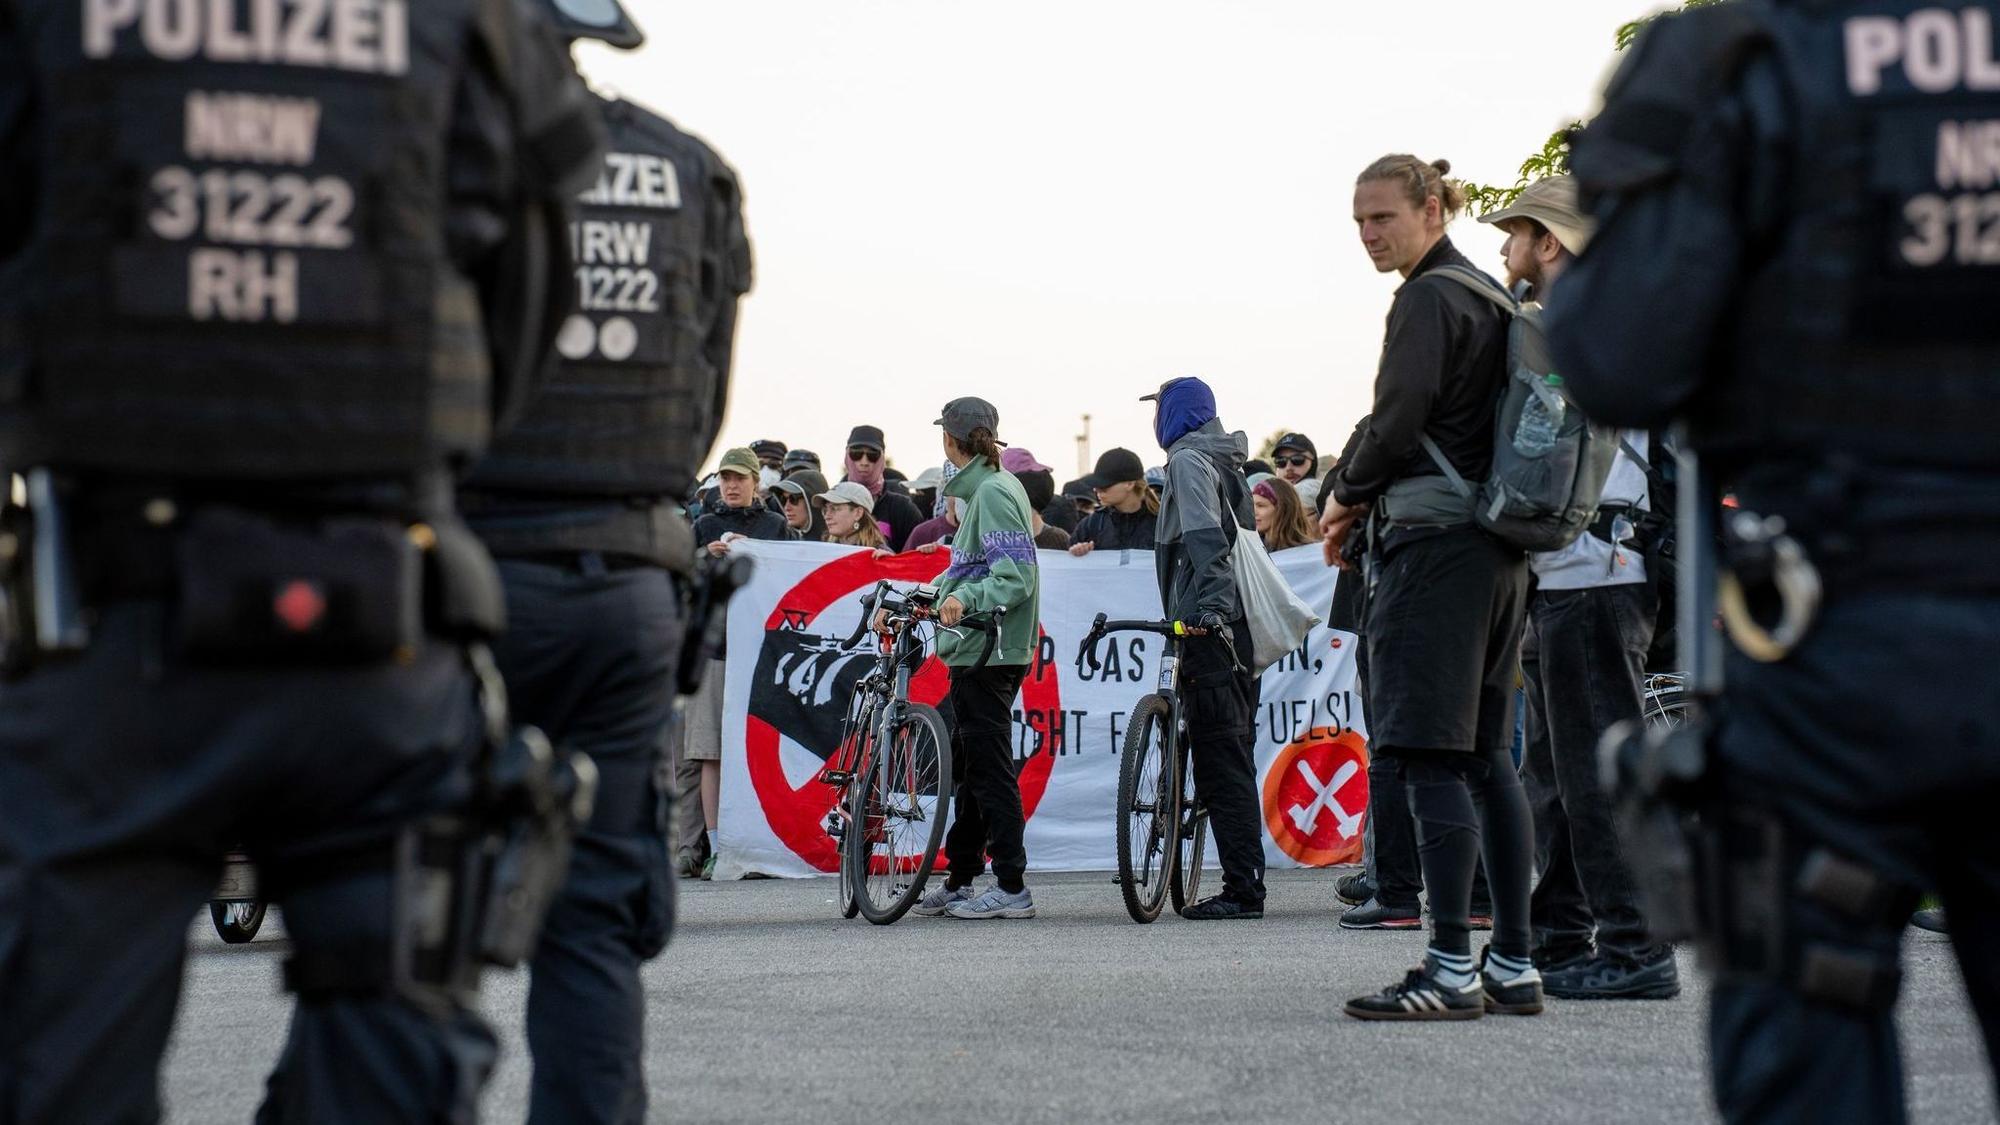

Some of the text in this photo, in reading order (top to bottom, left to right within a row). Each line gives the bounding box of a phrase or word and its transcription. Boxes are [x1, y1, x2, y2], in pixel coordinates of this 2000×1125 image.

[83, 0, 409, 75] POLIZEI
[184, 91, 321, 165] NRW
[149, 166, 354, 248] 31222
[579, 153, 682, 207] IZEI
[188, 248, 298, 321] RH
[575, 265, 659, 312] 1222
[1012, 709, 1087, 760] IGHT
[1256, 690, 1352, 744] UELS!
